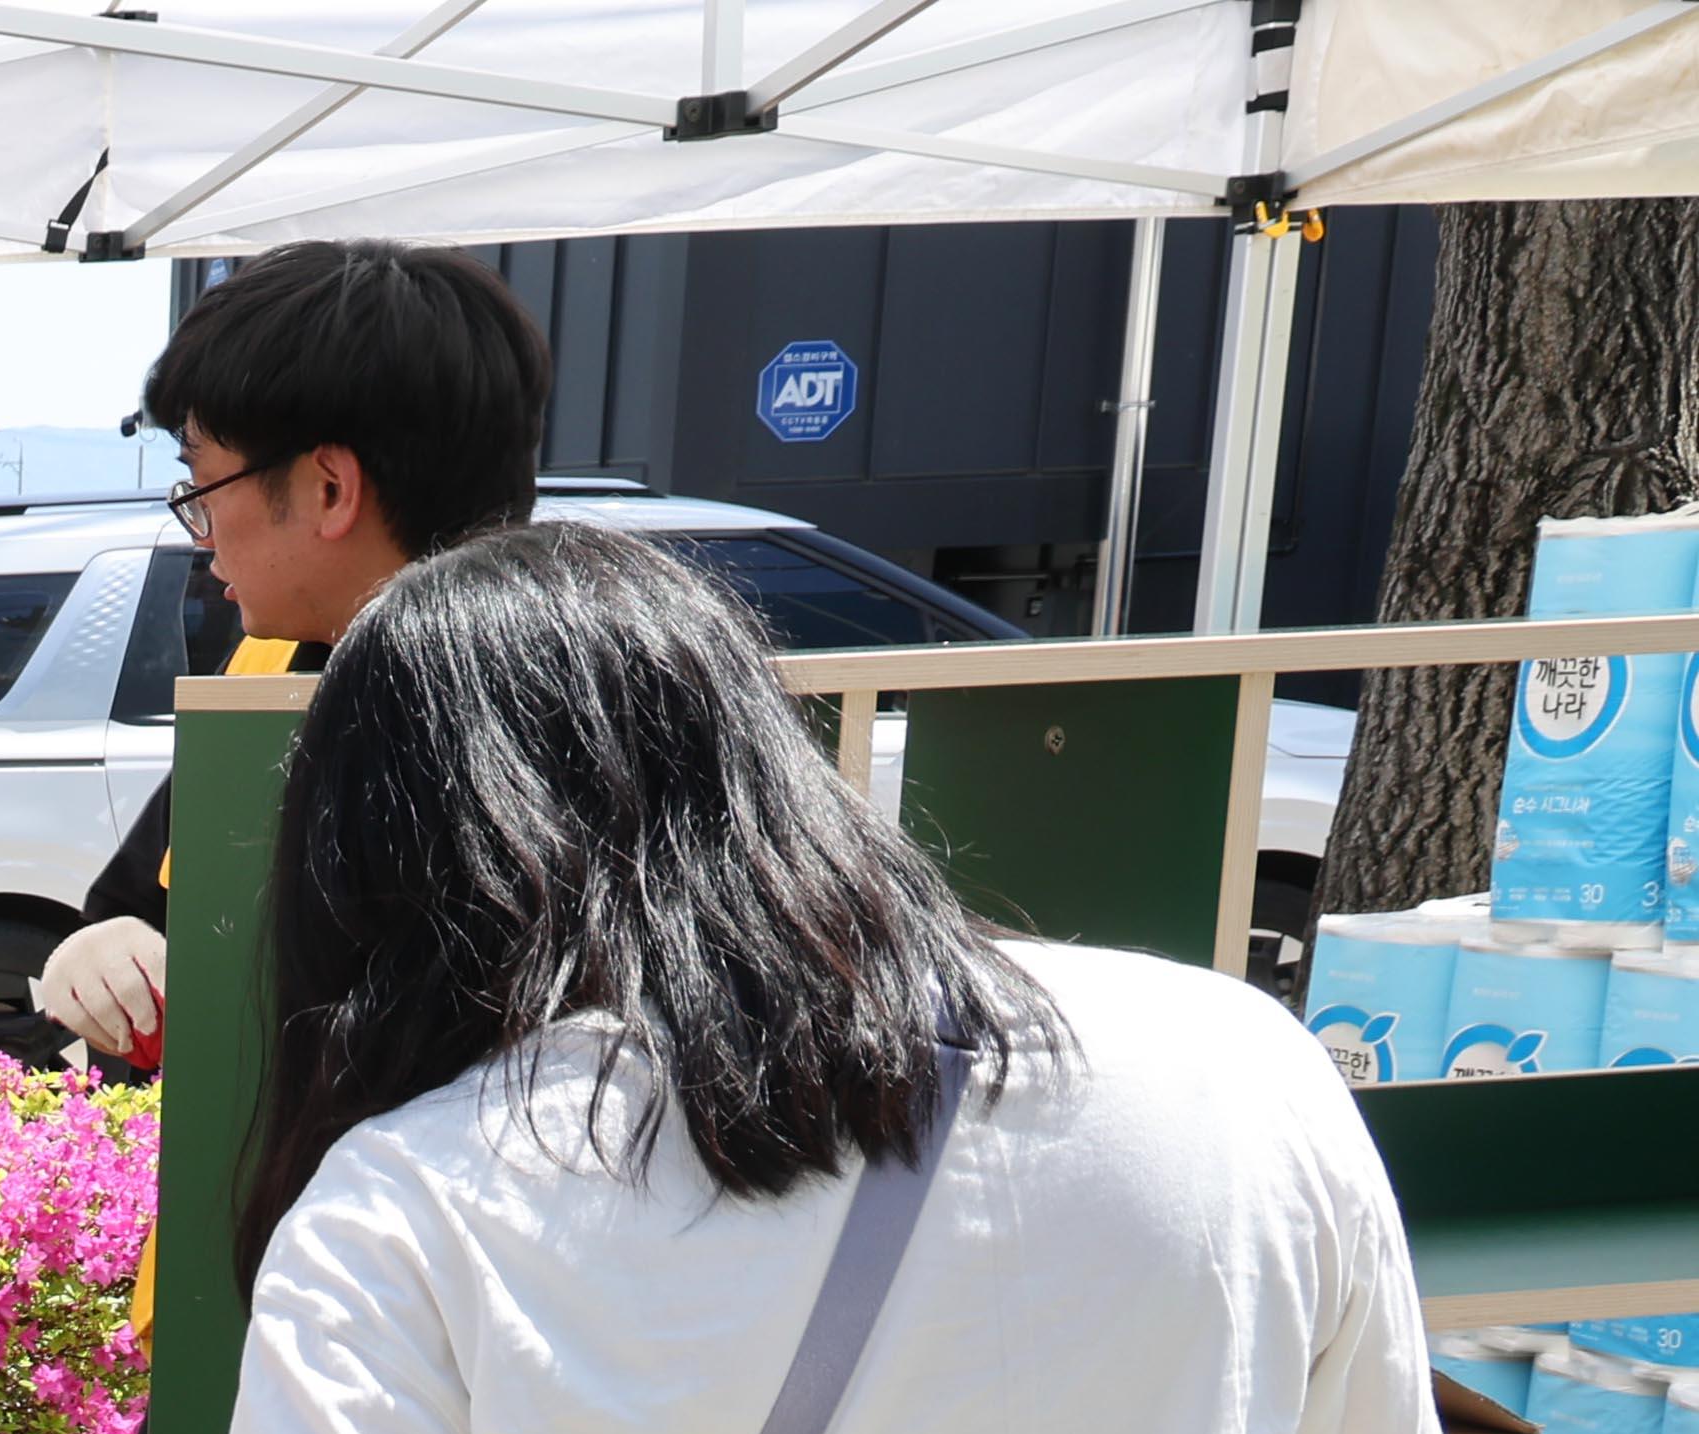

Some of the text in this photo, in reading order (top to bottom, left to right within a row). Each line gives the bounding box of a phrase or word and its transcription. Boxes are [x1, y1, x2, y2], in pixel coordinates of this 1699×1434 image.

[772, 371, 844, 408] ADT
[1535, 657, 1601, 690] 깨끗한
[1541, 692, 1587, 721] 나라
[1578, 883, 1605, 905] 30
[1656, 1327, 1682, 1350] 30
